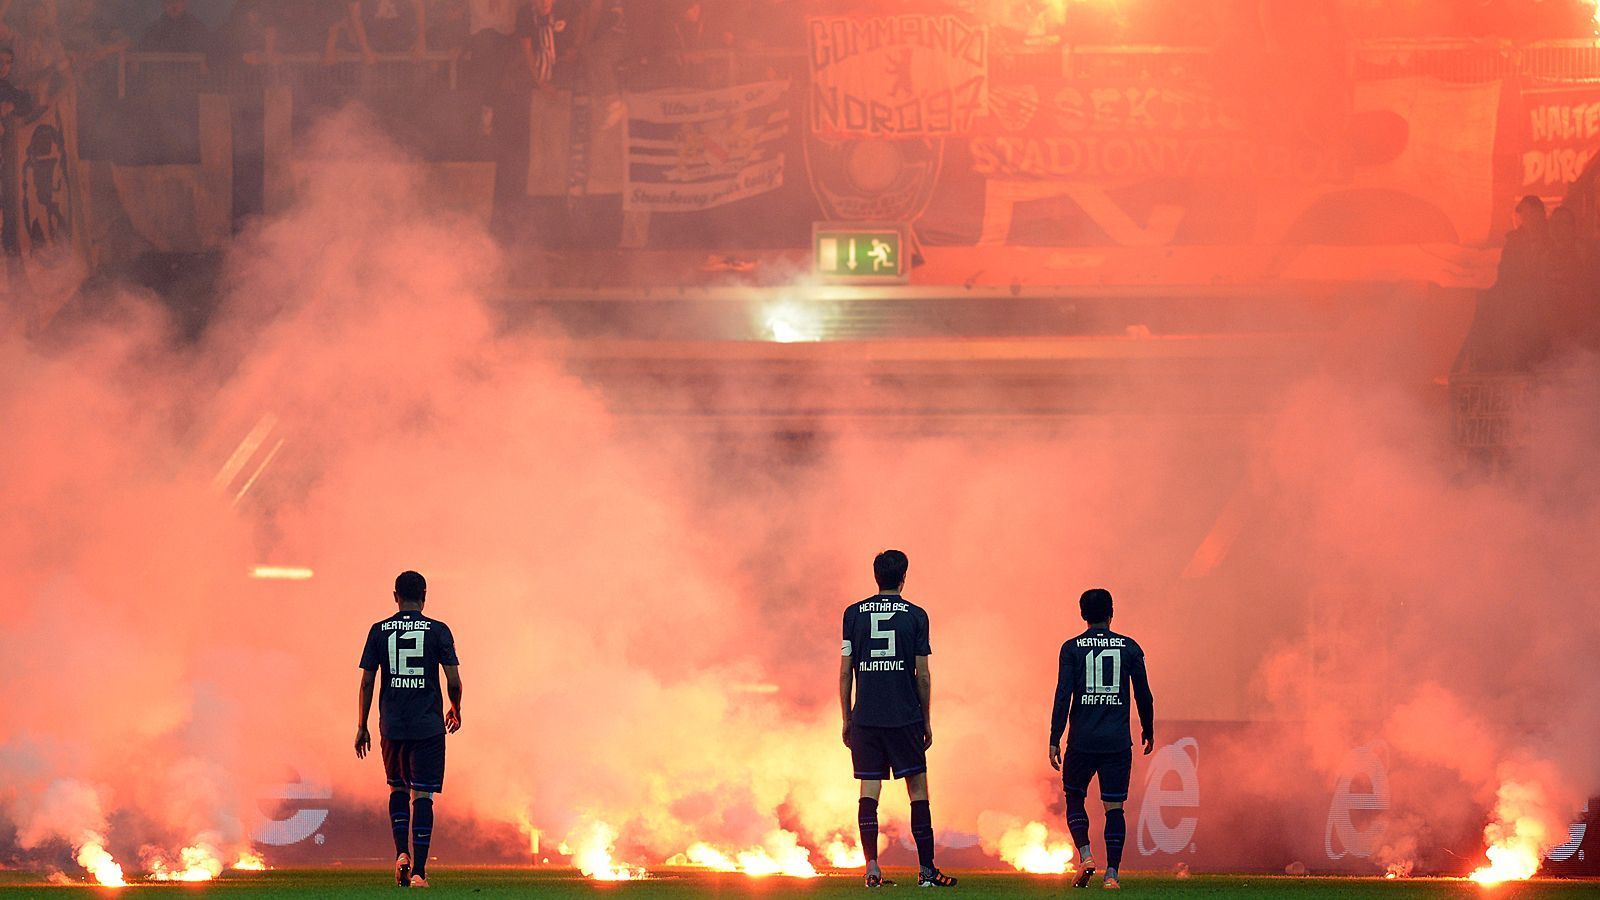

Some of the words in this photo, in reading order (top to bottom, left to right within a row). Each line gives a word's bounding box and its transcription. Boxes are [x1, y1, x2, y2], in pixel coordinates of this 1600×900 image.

[810, 16, 986, 71] COMMANDO
[859, 602, 891, 613] HERTHA
[892, 602, 909, 612] BSC
[381, 620, 413, 631] HERTHA
[414, 620, 431, 630] BSC
[870, 611, 896, 658] 5
[1076, 637, 1109, 648] HERTHA
[1109, 638, 1126, 647] BSC
[387, 630, 425, 676] 12
[1085, 648, 1121, 694] 10
[391, 677, 425, 689] RONNY
[1081, 694, 1123, 705] RAFFAEL
